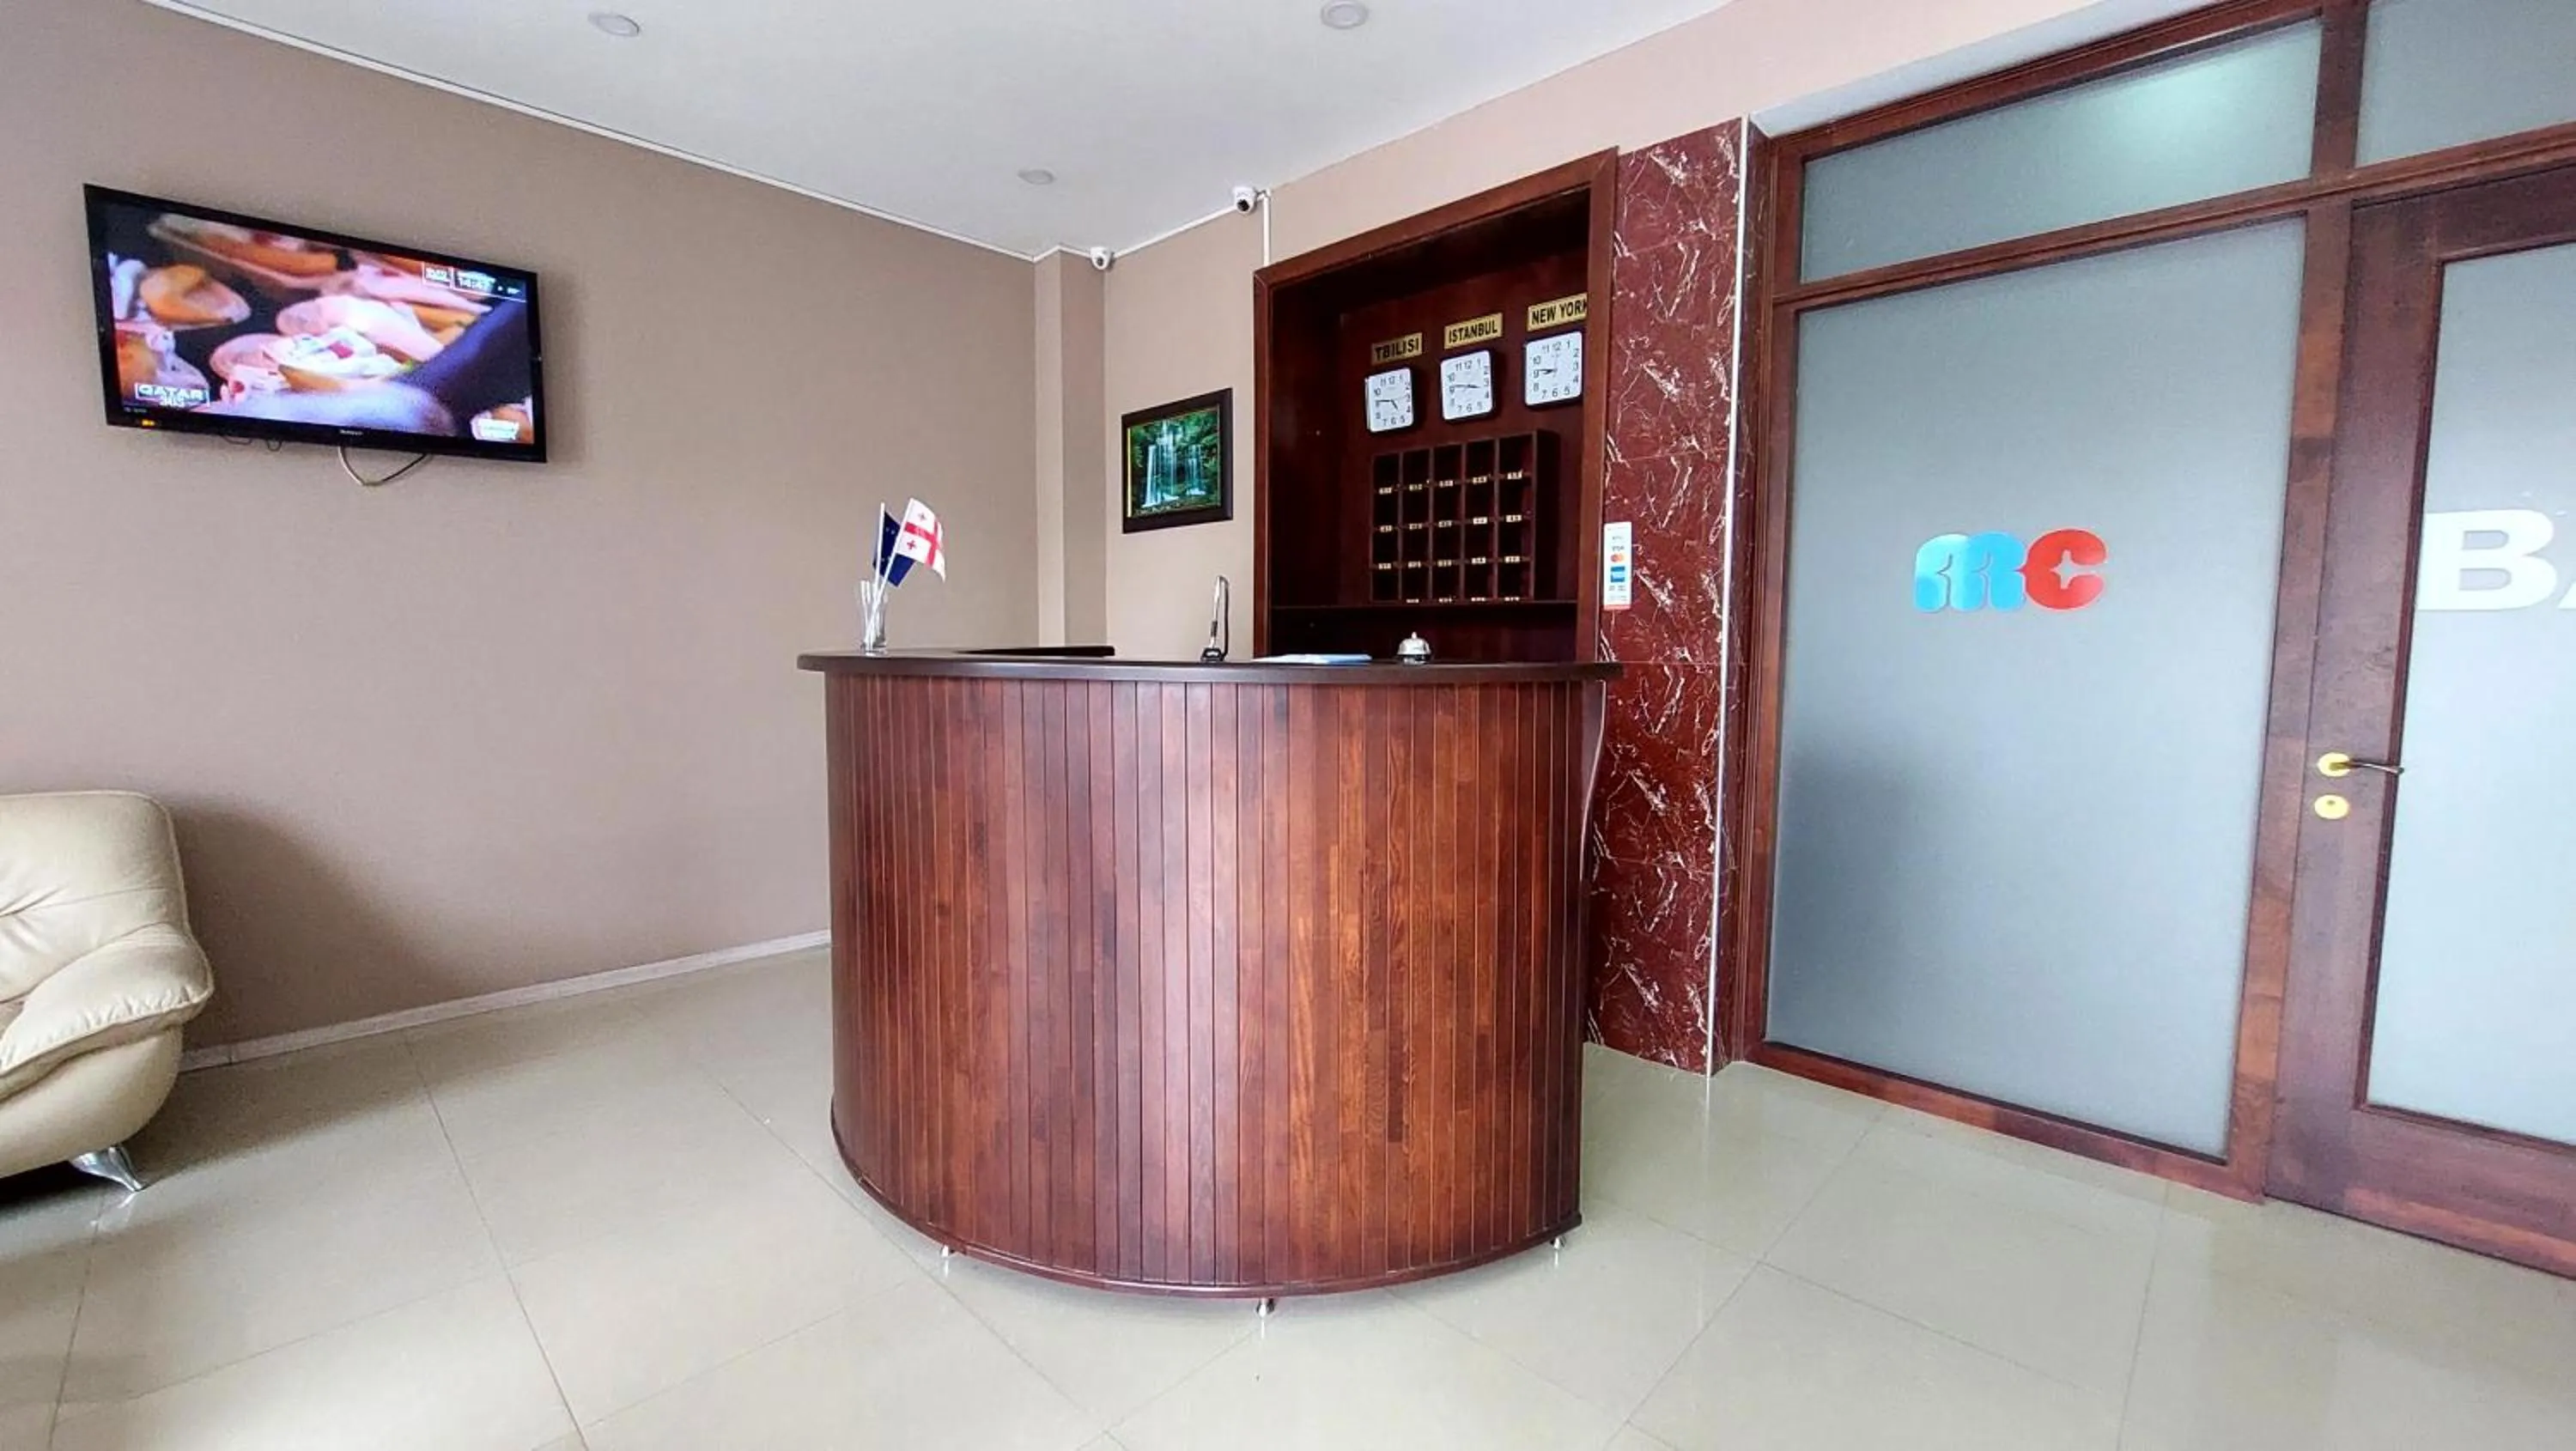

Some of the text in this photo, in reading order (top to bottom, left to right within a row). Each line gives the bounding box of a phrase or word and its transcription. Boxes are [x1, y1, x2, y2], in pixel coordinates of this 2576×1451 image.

[1531, 305, 1557, 325] NEW
[1449, 319, 1498, 343] ISTANBUL
[1375, 337, 1419, 361] TBILISI
[138, 384, 204, 400] QATAR
